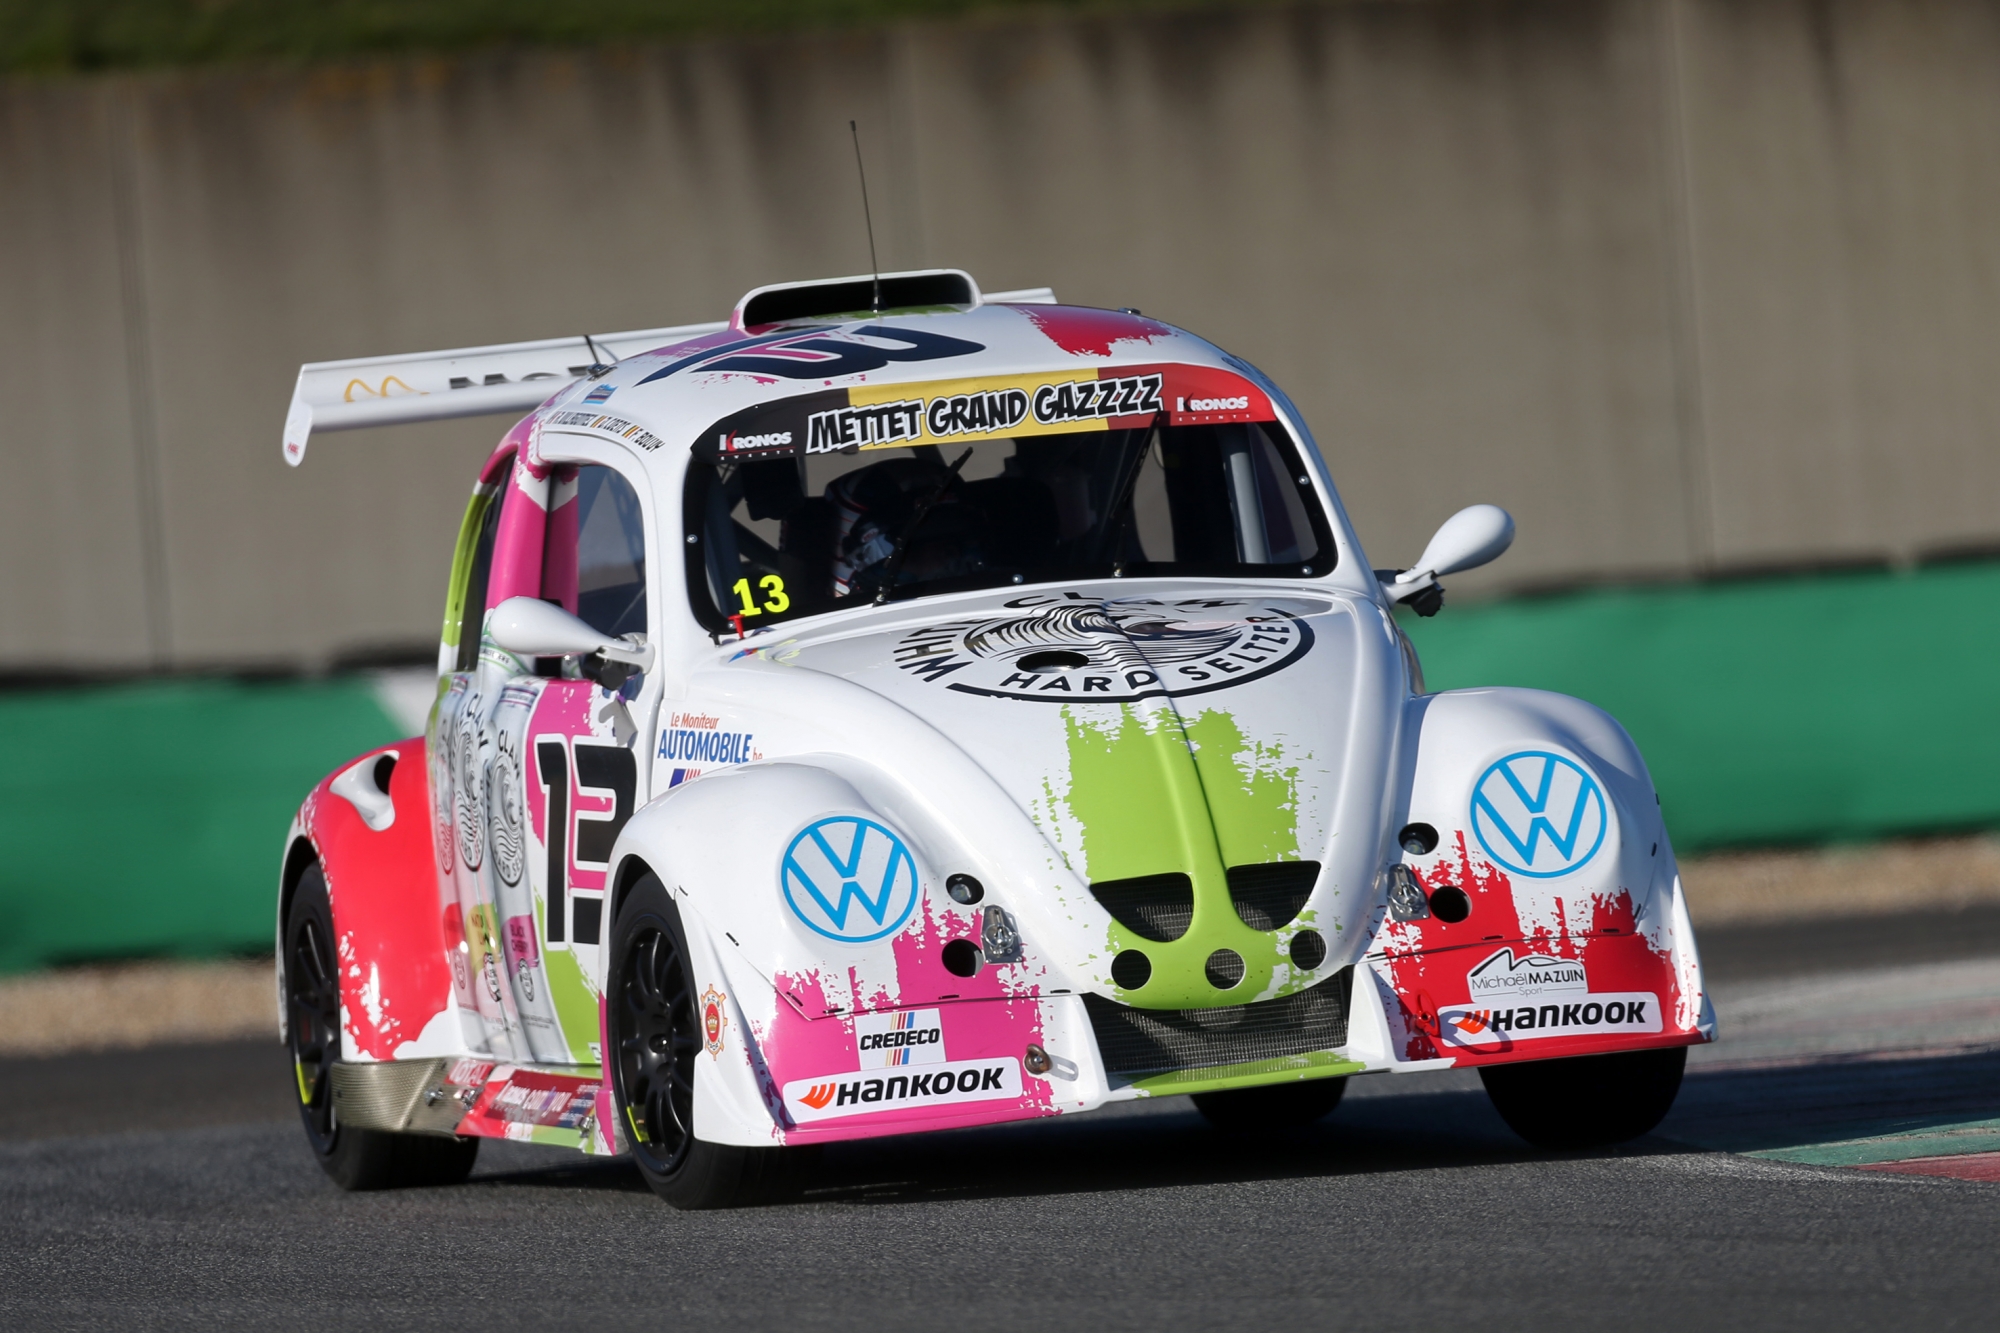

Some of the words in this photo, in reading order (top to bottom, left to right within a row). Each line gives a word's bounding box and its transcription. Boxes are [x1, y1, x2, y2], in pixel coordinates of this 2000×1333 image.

[806, 399, 925, 454] METTET
[925, 388, 1031, 437] GRAND
[1032, 373, 1163, 425] GAZZZZ
[1177, 392, 1249, 413] KRONOS
[1179, 413, 1250, 422] EVENTS
[719, 429, 793, 452] KRONOS
[721, 449, 794, 461] EVENTS
[733, 574, 790, 617] 13
[999, 670, 1159, 692] HARD
[1178, 616, 1291, 681] SELTZER
[670, 712, 680, 728] Le
[681, 712, 720, 729] Moniteur
[657, 729, 753, 764] AUTOMOBILE
[536, 741, 638, 945] 13
[1518, 987, 1543, 998] Sport
[860, 1028, 940, 1051] CREDECO
